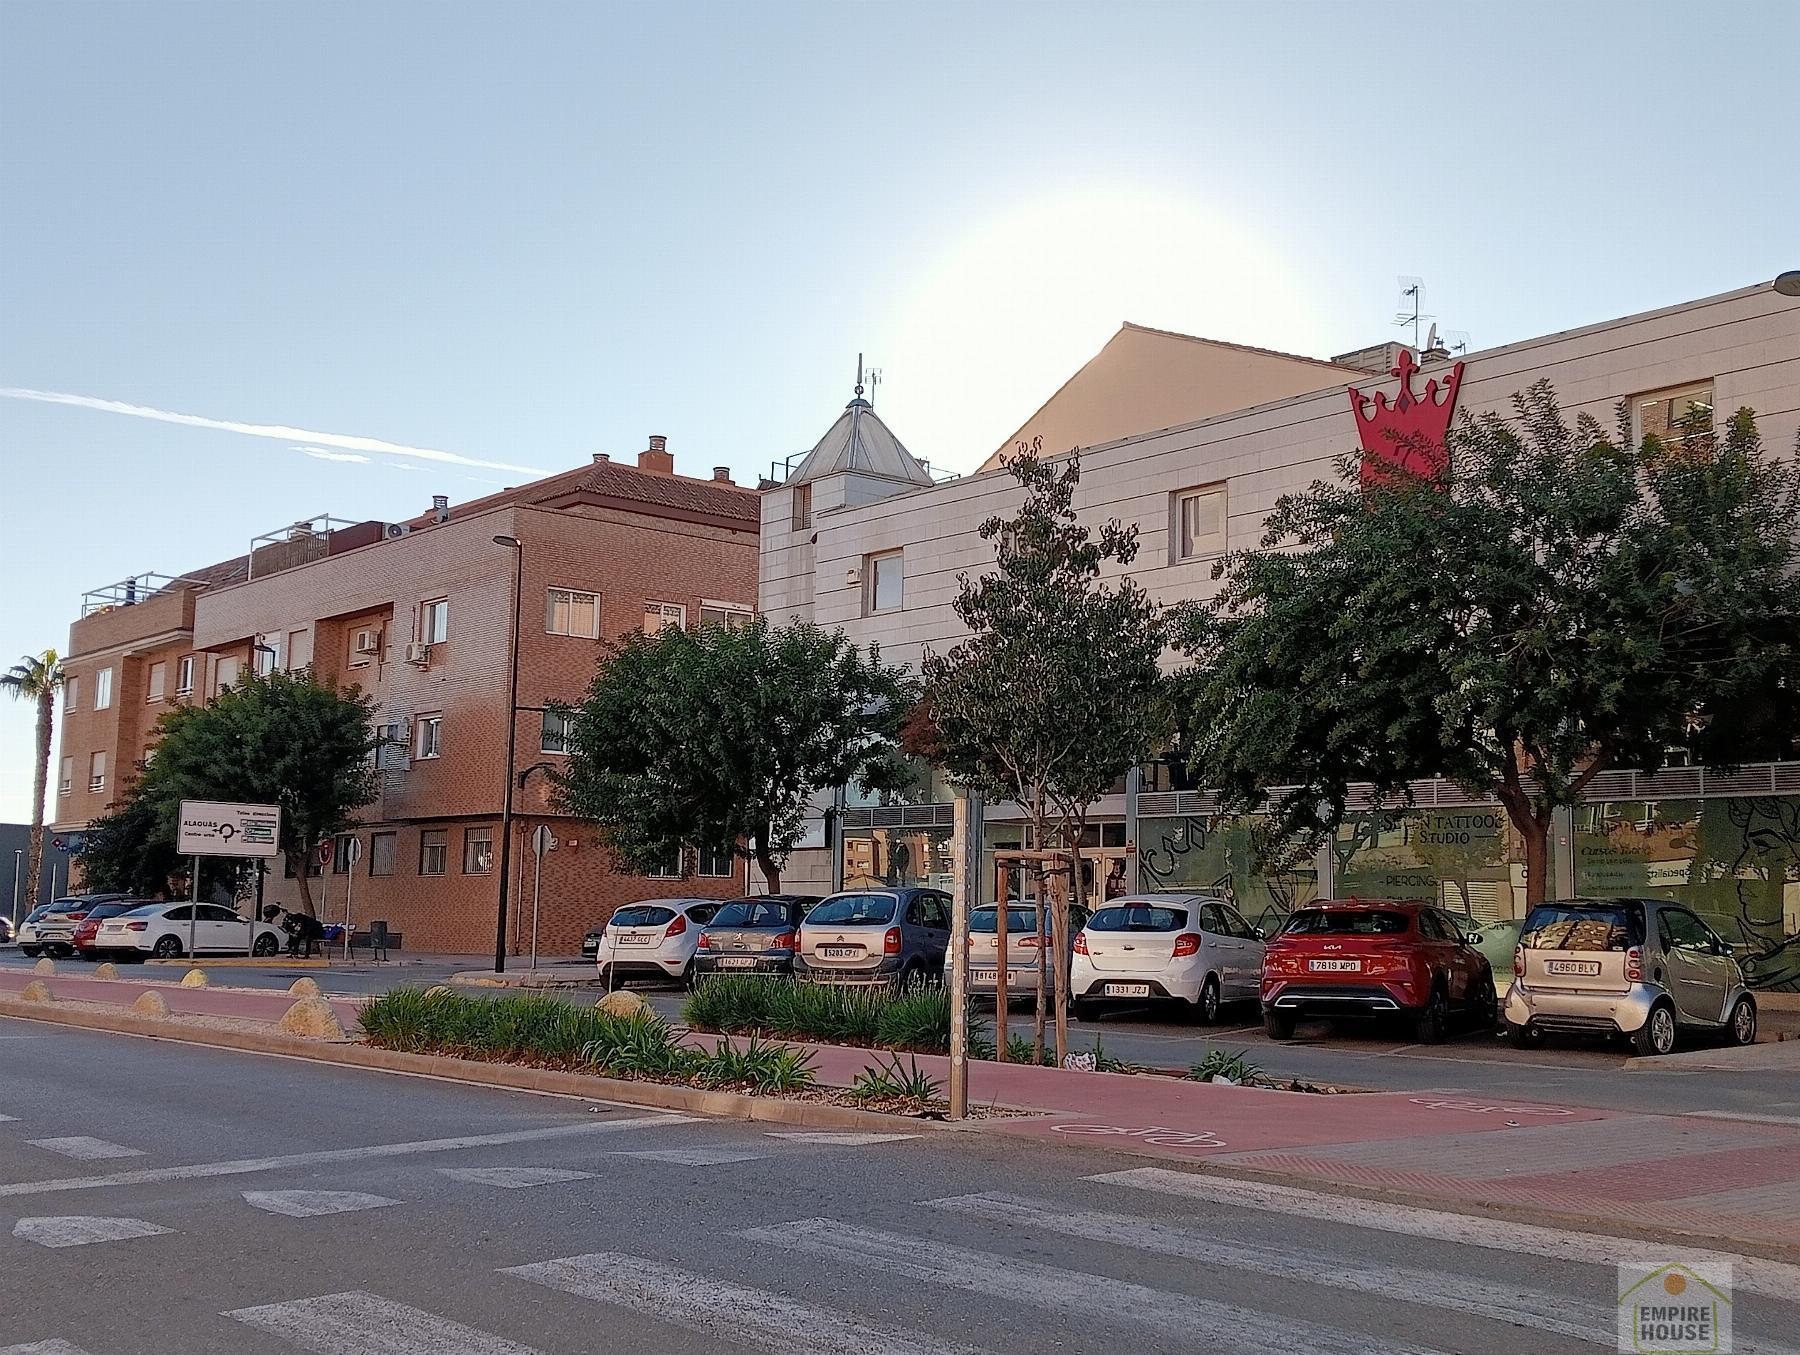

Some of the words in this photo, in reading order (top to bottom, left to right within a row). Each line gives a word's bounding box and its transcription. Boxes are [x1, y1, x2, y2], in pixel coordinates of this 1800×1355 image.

[1420, 831, 1470, 845] STUDIO
[1316, 961, 1337, 970] 7819
[1553, 963, 1577, 972] 4960
[1578, 963, 1596, 974] BLK
[1112, 985, 1129, 994] 1331
